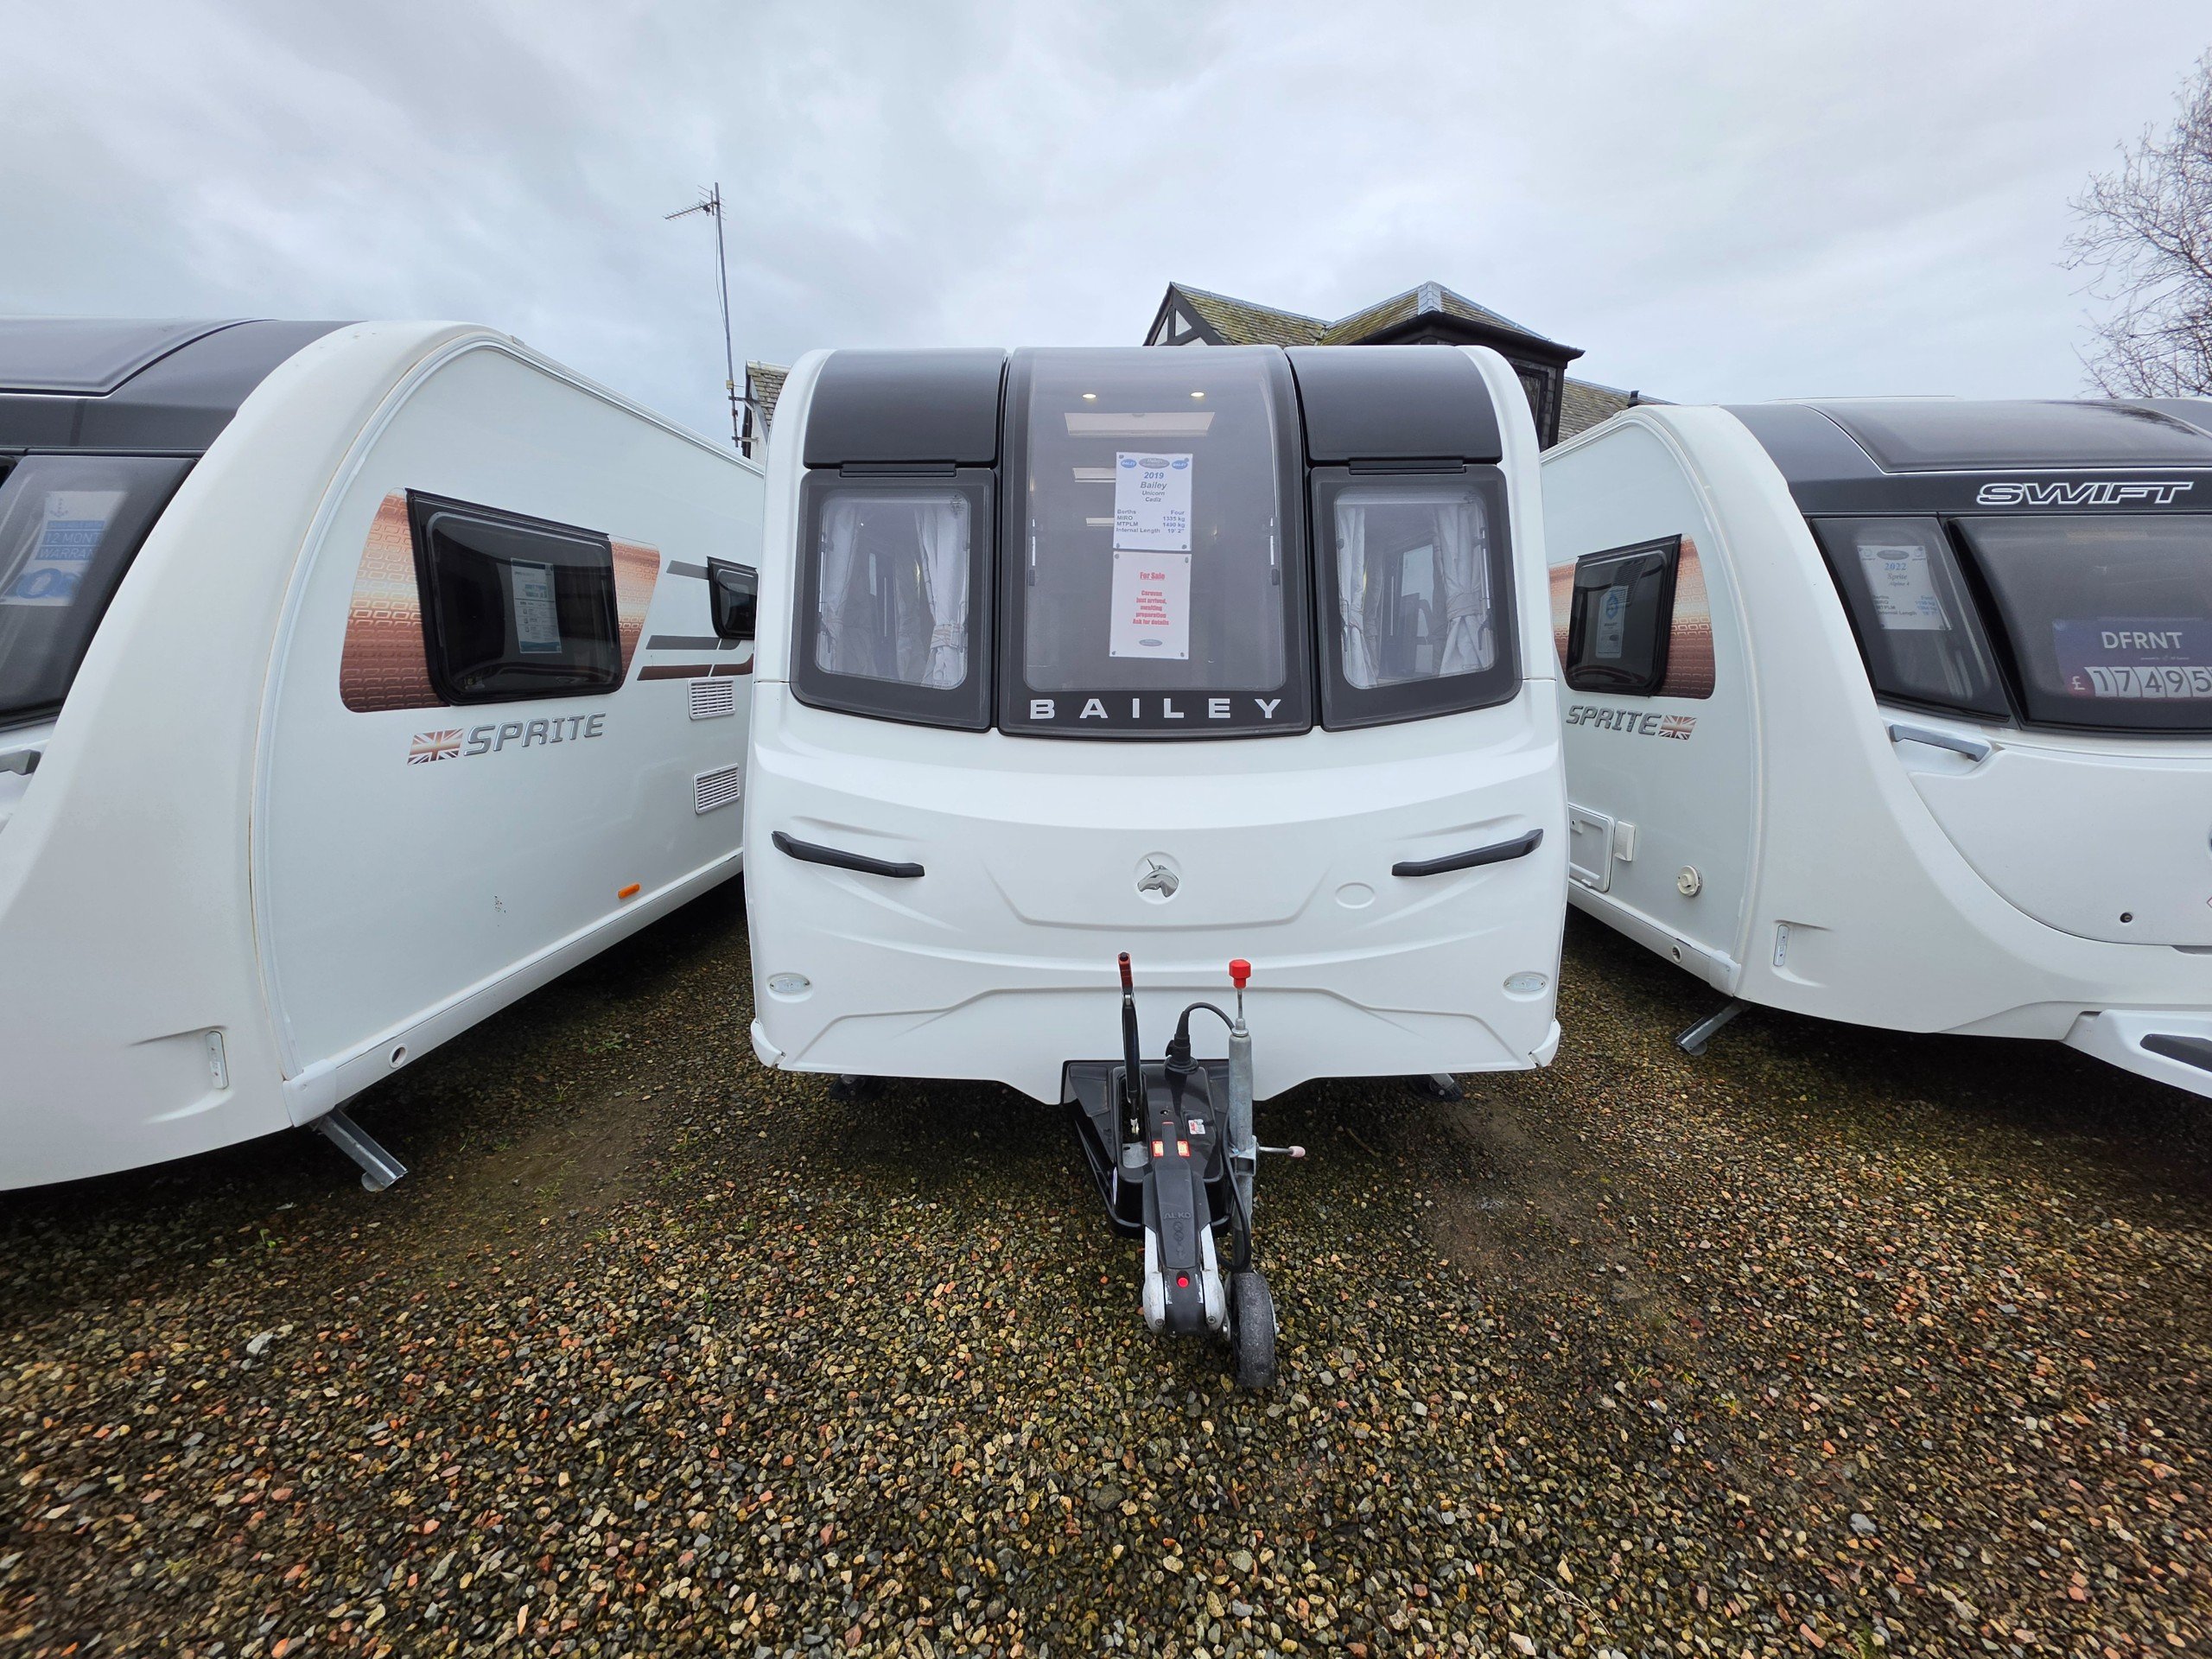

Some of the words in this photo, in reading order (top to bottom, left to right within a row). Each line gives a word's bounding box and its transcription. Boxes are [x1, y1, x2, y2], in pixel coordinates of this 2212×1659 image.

[1141, 481, 1167, 490] Bailey
[1976, 481, 2195, 505] SWIFT
[46, 532, 58, 543] 12
[2101, 632, 2183, 649] DFRNT
[1030, 698, 1281, 720] BAILEY
[1566, 705, 1662, 735] SPRITE
[463, 712, 607, 756] SPRITE
